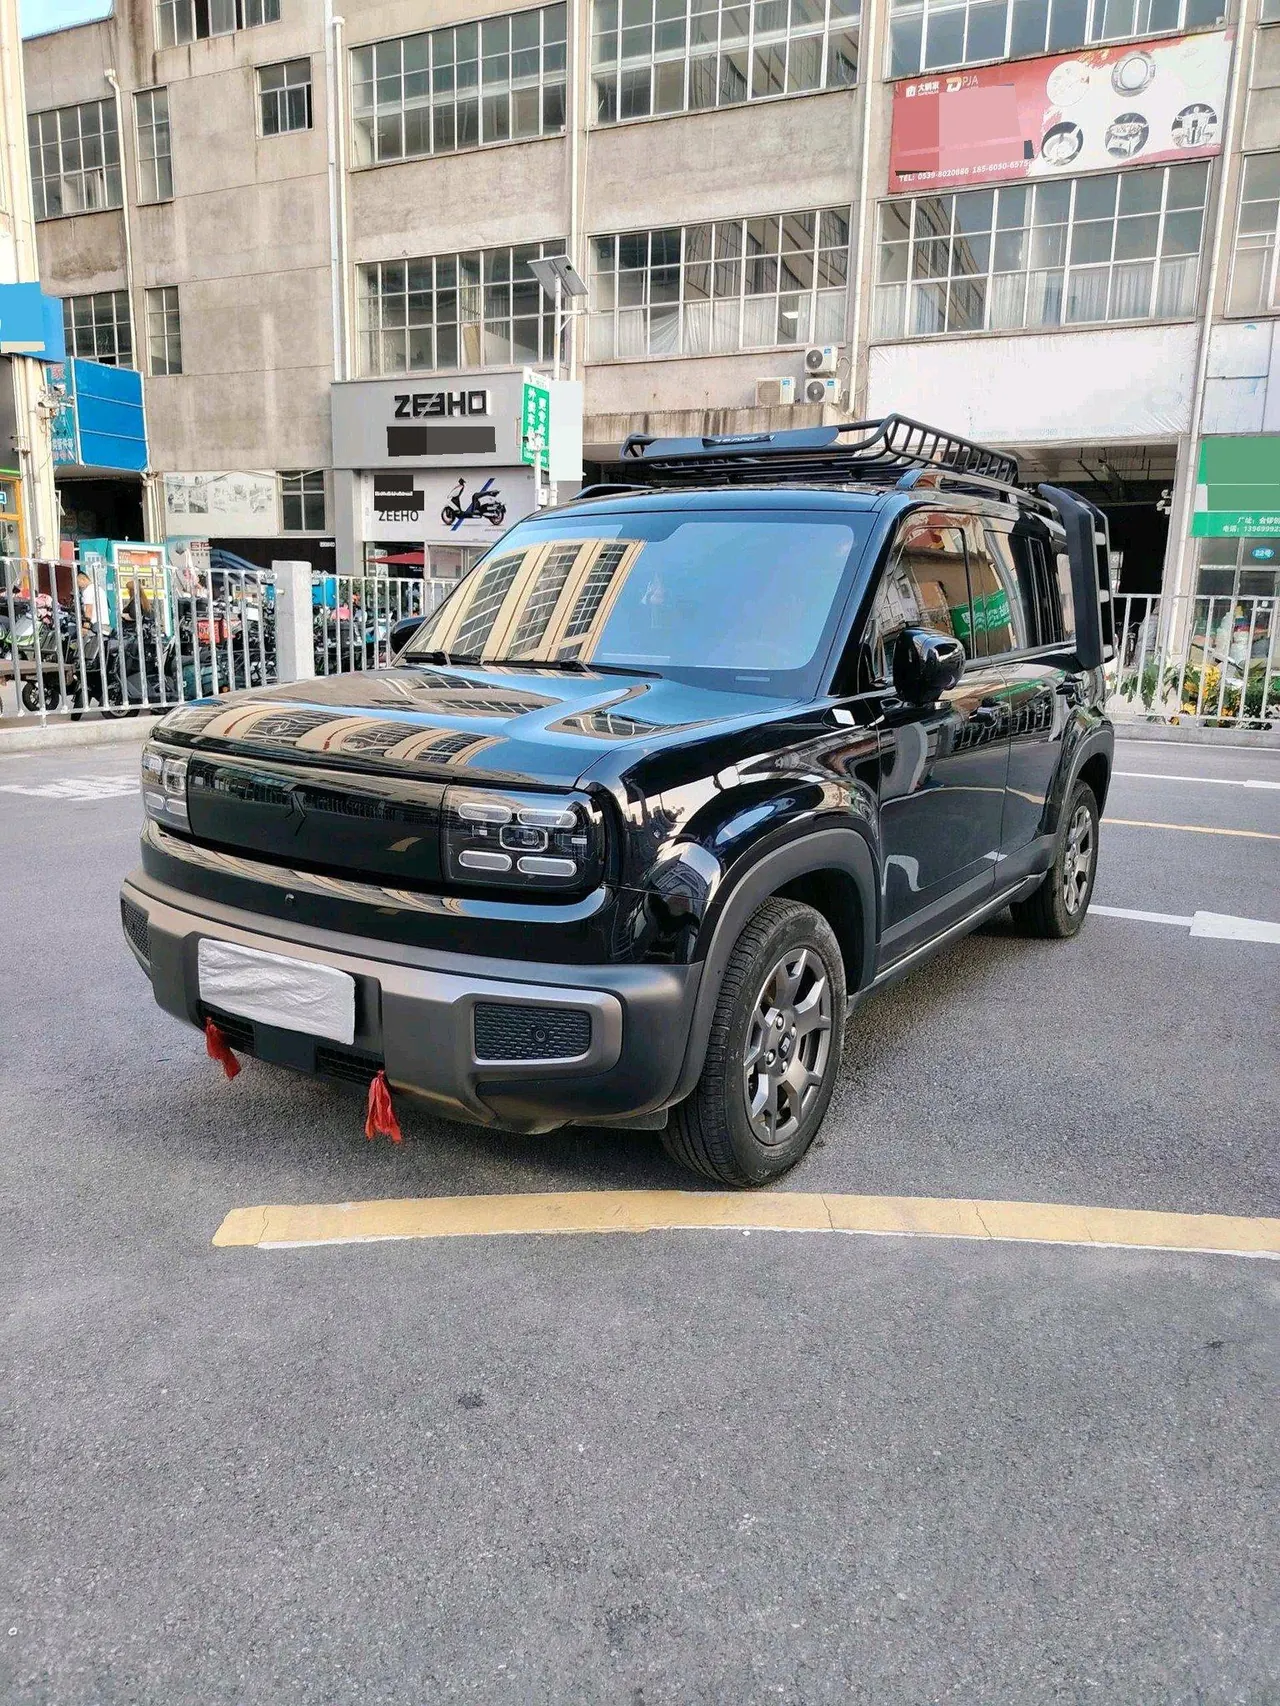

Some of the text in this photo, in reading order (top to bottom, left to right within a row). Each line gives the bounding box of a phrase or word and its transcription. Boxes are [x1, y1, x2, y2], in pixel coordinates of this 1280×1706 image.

[899, 173, 915, 182] TEL:
[394, 389, 489, 418] ZEEHO
[378, 510, 419, 522] ZEEHO
